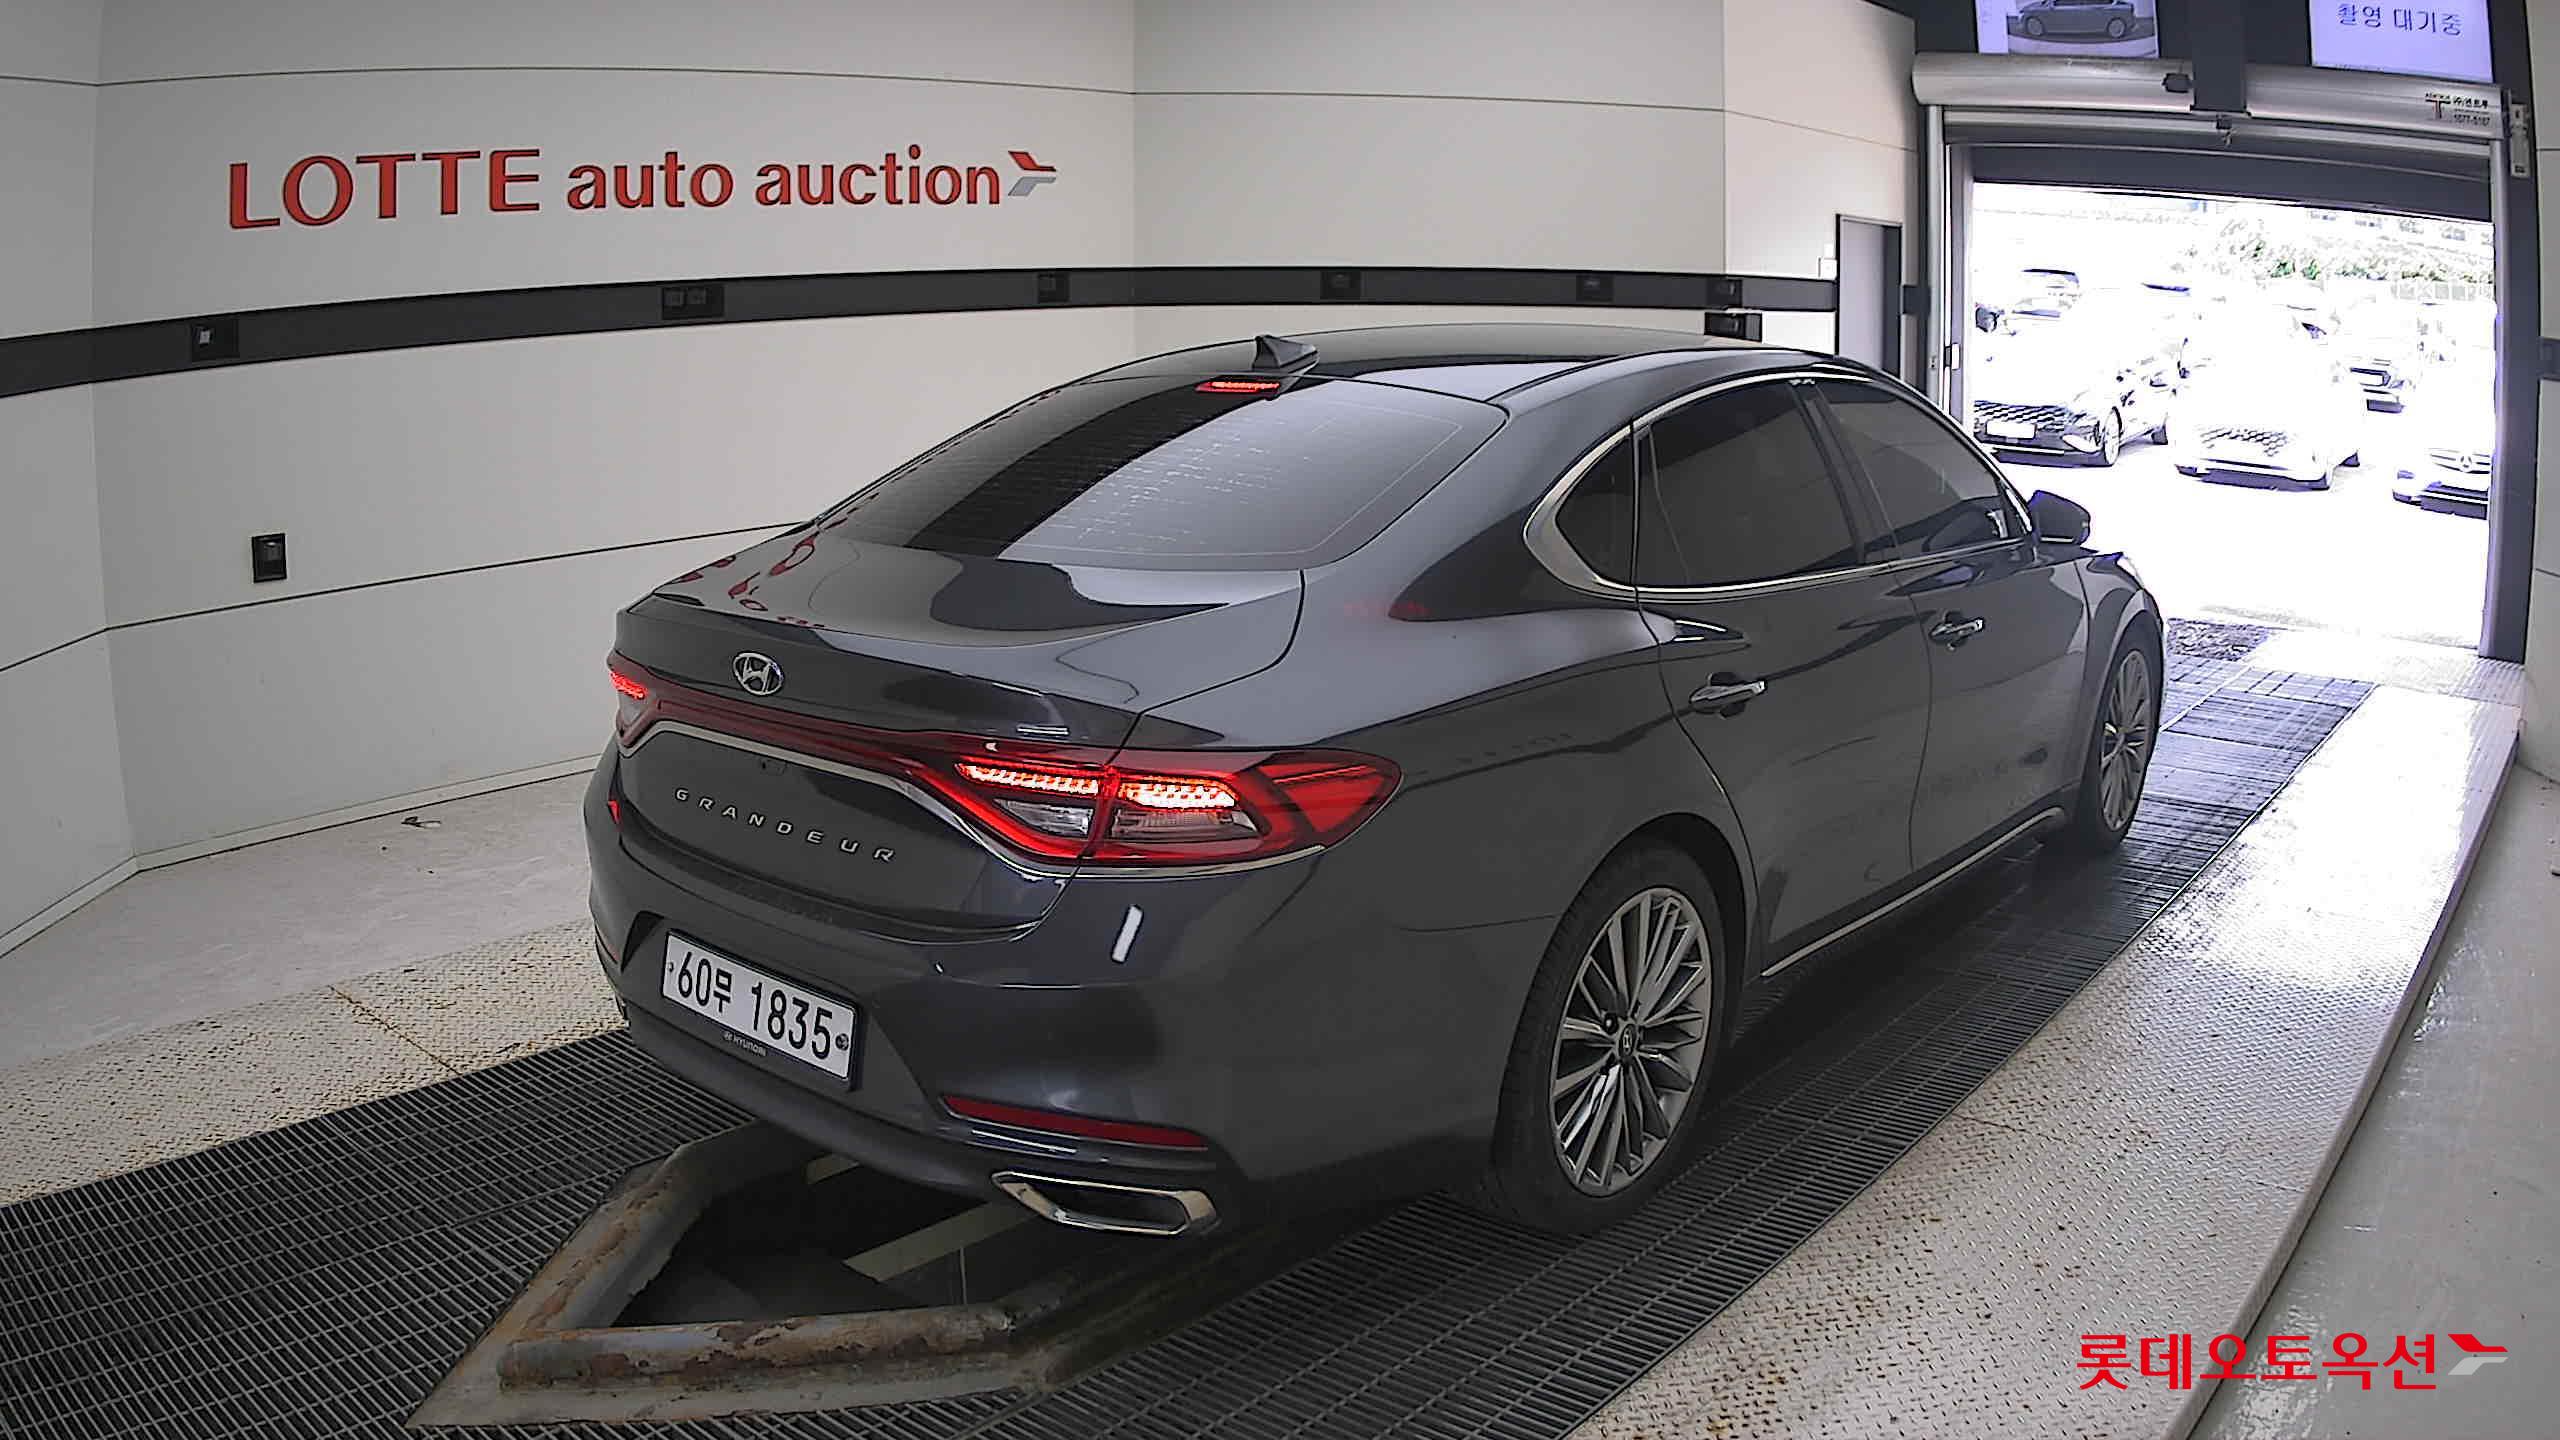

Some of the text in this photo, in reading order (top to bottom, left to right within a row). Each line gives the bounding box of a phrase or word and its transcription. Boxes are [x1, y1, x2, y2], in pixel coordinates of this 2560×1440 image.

[2393, 7, 2461, 36] 대기중
[229, 143, 1001, 230] LOTTE auto auction
[675, 788, 894, 862] GRANDEUR
[677, 951, 834, 1060] 60무 1835
